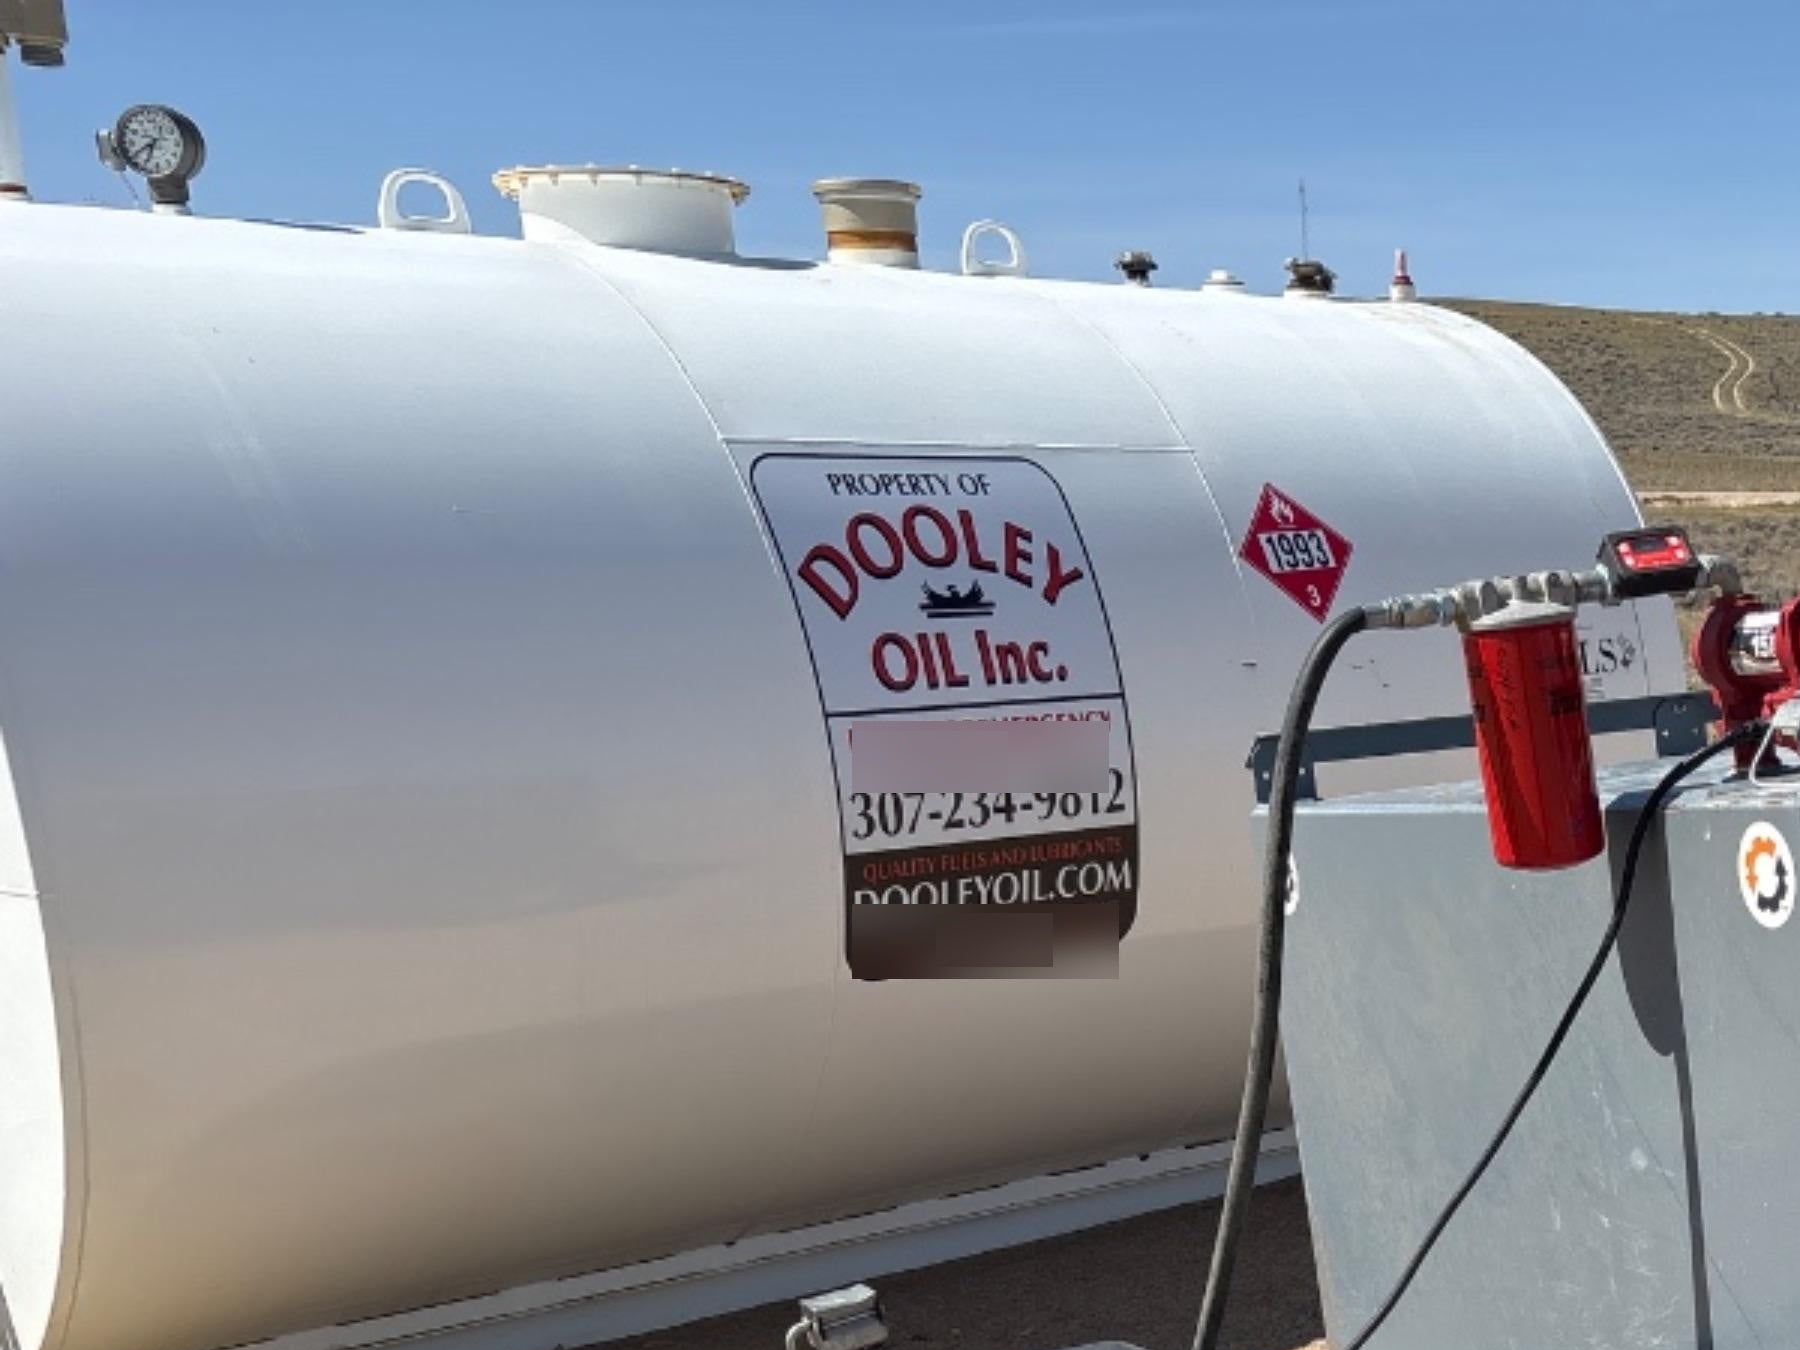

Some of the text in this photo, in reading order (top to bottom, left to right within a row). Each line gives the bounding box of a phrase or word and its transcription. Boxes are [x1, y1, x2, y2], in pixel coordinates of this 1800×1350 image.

[825, 472, 991, 496] PROPERTY OF
[797, 504, 1085, 621] DOOLEY
[1265, 531, 1330, 571] 1993
[1306, 583, 1321, 607] 3
[871, 628, 1069, 693] OIL Inc.
[863, 836, 1122, 884] QUALITY FUELS AND LUBRICANTS
